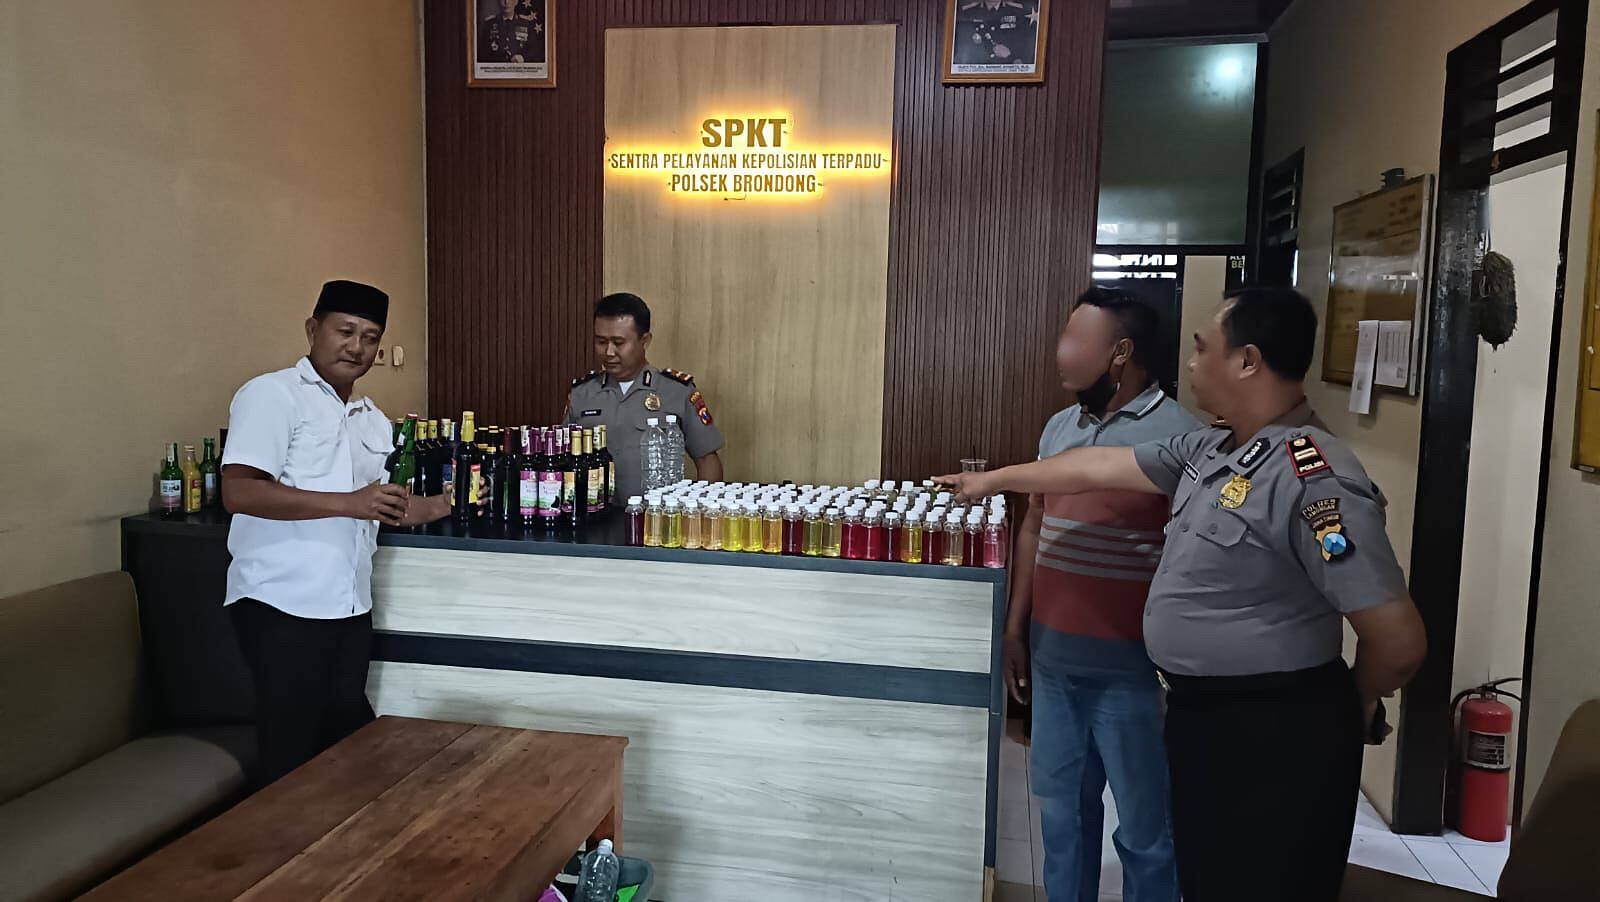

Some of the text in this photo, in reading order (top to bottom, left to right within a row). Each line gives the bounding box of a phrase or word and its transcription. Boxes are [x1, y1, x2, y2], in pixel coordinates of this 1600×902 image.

[701, 118, 787, 148] SPKT
[611, 153, 882, 169] SENTRA PELAYANAN KEPOLISIAN TERPADU
[671, 174, 817, 193] POLSEK BRONDONG
[1298, 460, 1325, 473] POLISI
